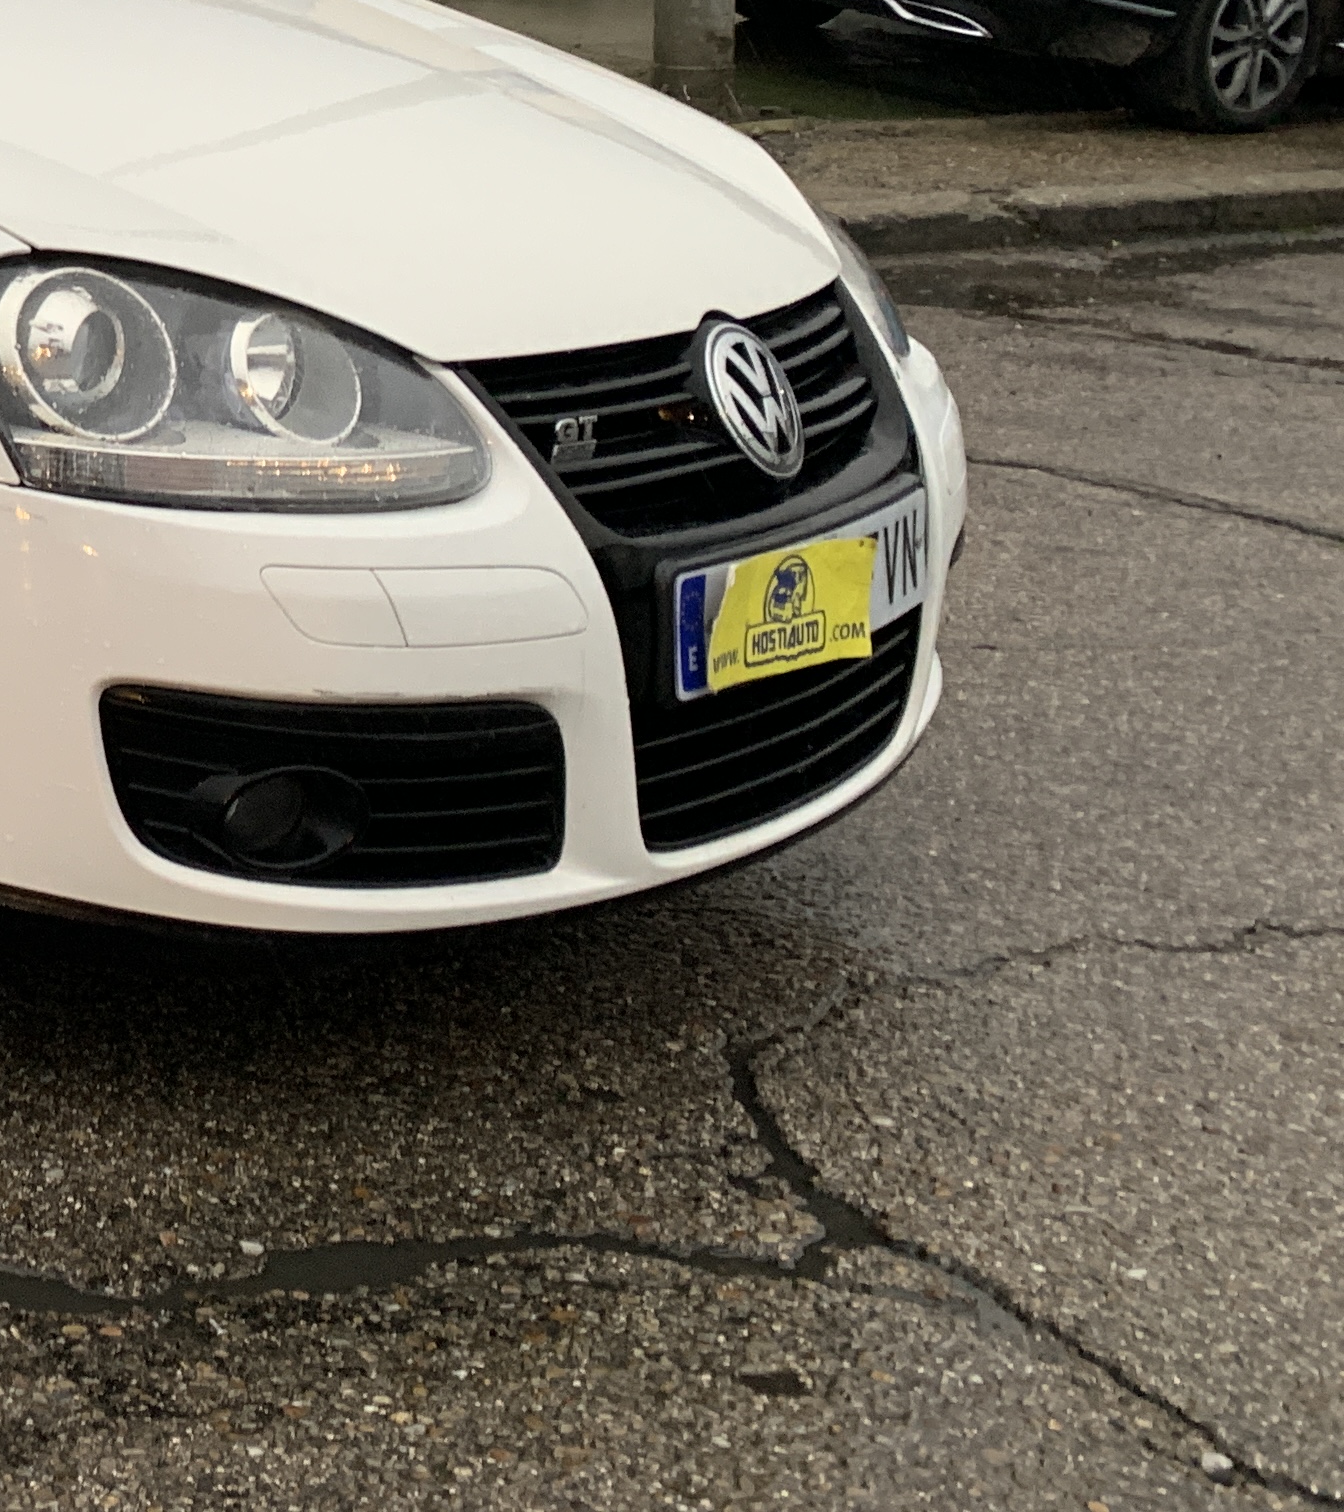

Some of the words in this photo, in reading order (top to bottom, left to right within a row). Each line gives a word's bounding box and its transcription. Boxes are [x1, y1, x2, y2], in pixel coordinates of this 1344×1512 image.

[555, 414, 598, 443] GT
[873, 510, 918, 605] VN
[751, 619, 820, 656] HOSTIAUTO
